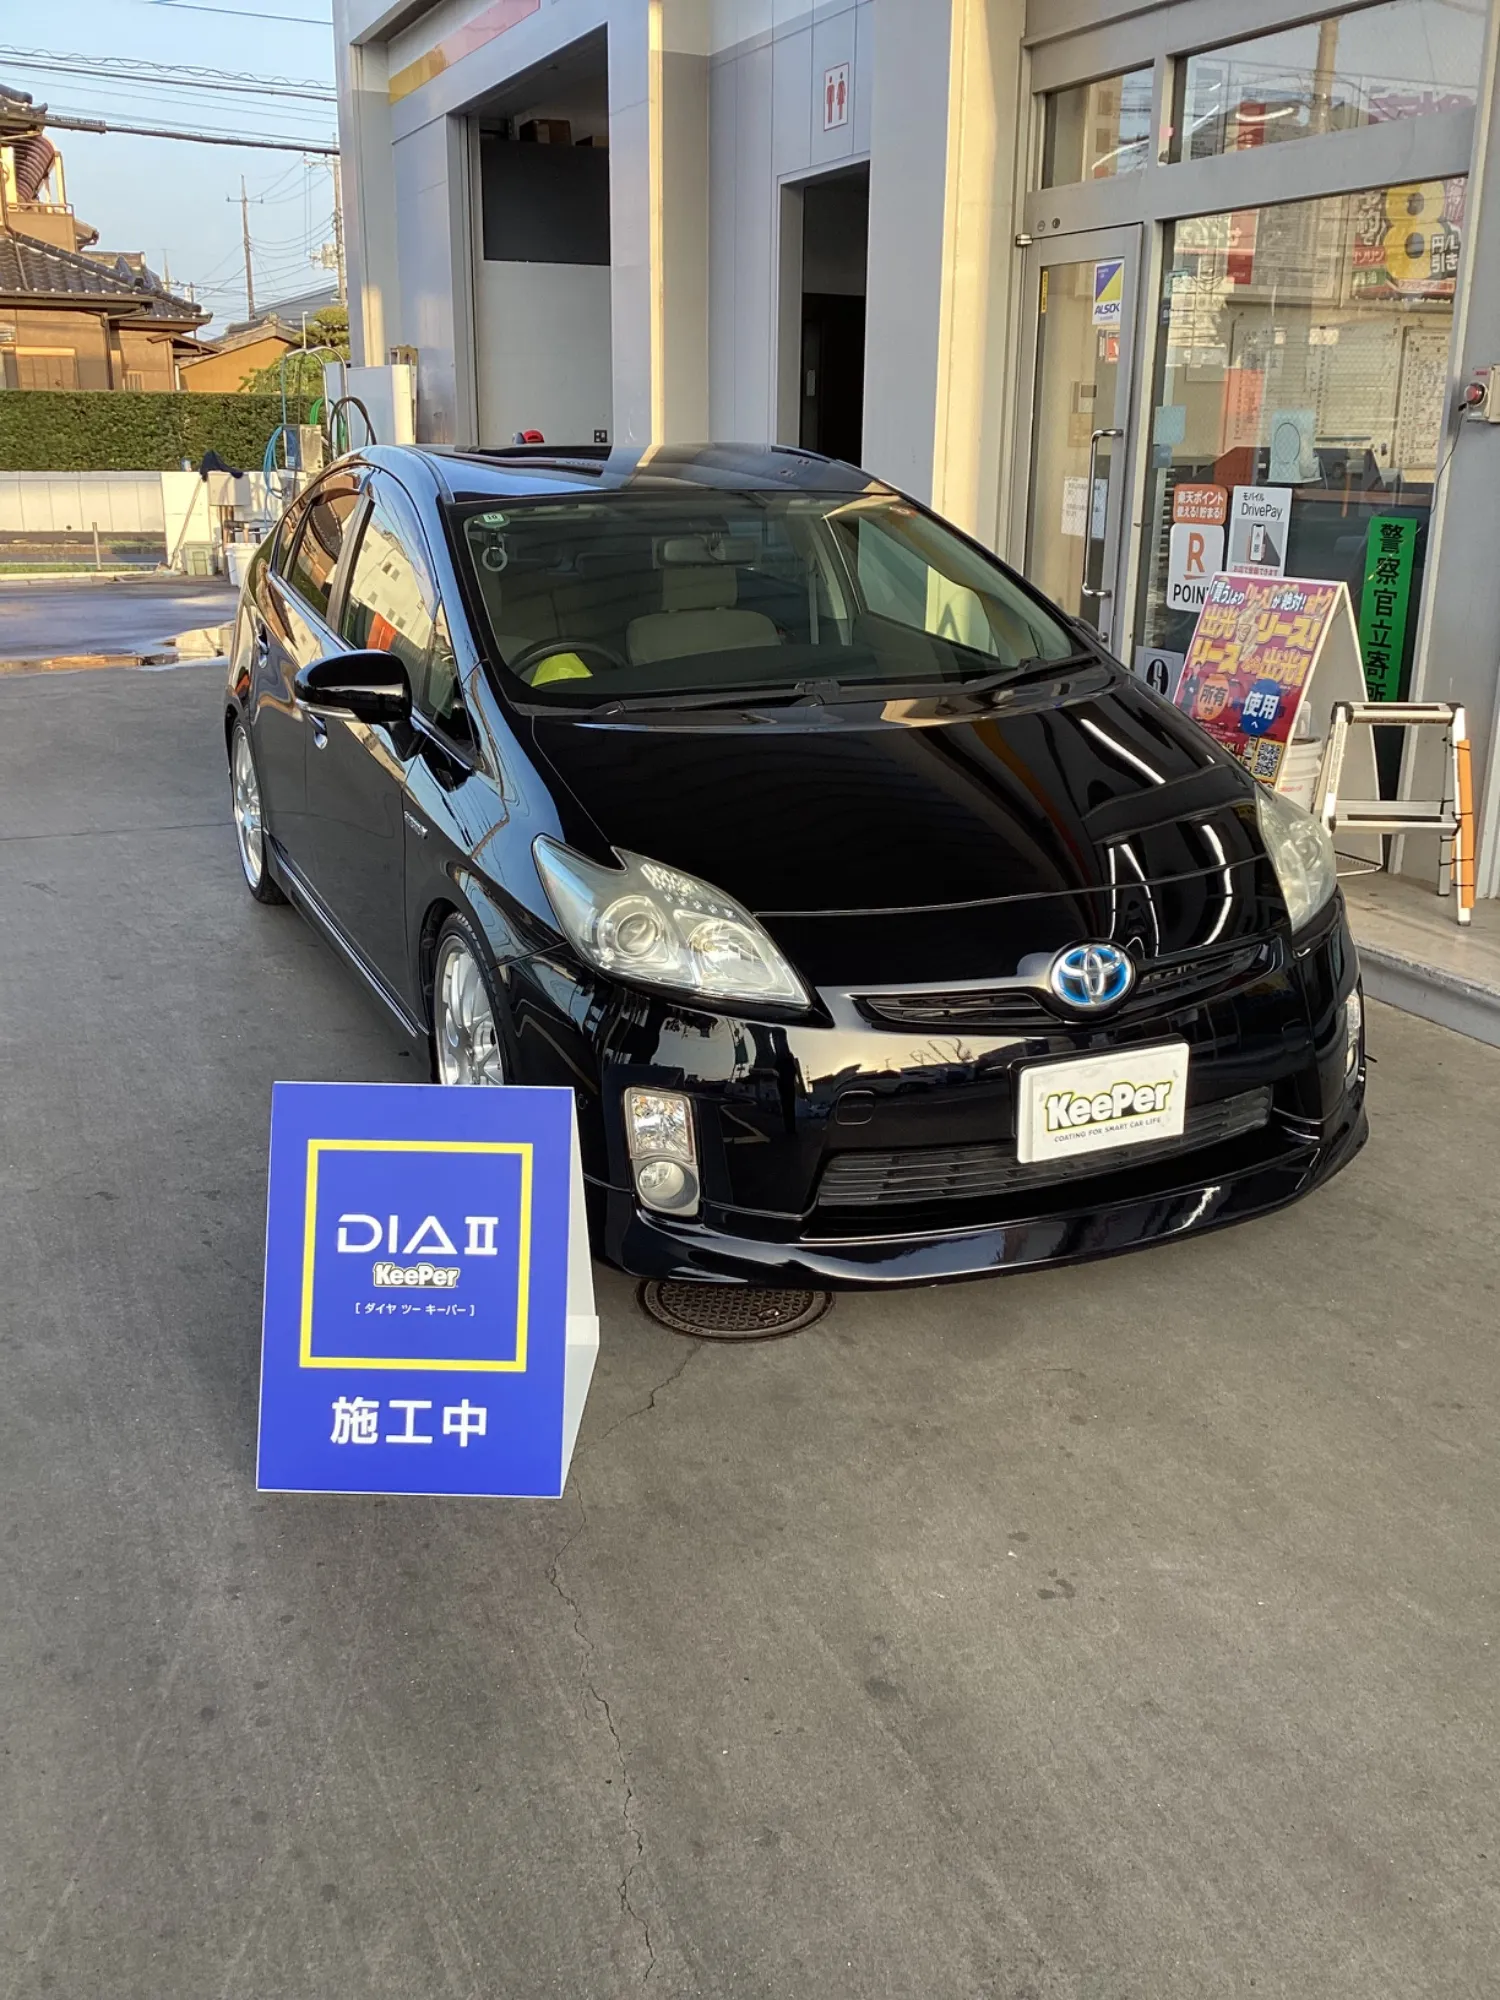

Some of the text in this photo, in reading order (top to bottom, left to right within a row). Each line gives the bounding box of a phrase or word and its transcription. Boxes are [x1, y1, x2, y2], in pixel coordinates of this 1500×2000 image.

[1383, 180, 1445, 280] 8
[1431, 254, 1459, 273] 引き
[1178, 491, 1224, 505] 楽天ポイント
[1243, 492, 1265, 502] モバイル
[1241, 502, 1283, 520] DrivePay
[1173, 584, 1210, 605] POIN
[1366, 523, 1405, 702] 警察官立寄所
[1200, 684, 1228, 707] 所有
[1243, 690, 1280, 720] 使用
[1045, 1081, 1172, 1132] KeePer
[1054, 1117, 1162, 1143] COATING FOR SMART CAR LIFE
[373, 1262, 460, 1289] KeePer
[364, 1302, 397, 1315] ダイヤ
[401, 1304, 421, 1315] ツー
[425, 1303, 467, 1316] キーパー
[330, 1396, 488, 1448] 施工中
